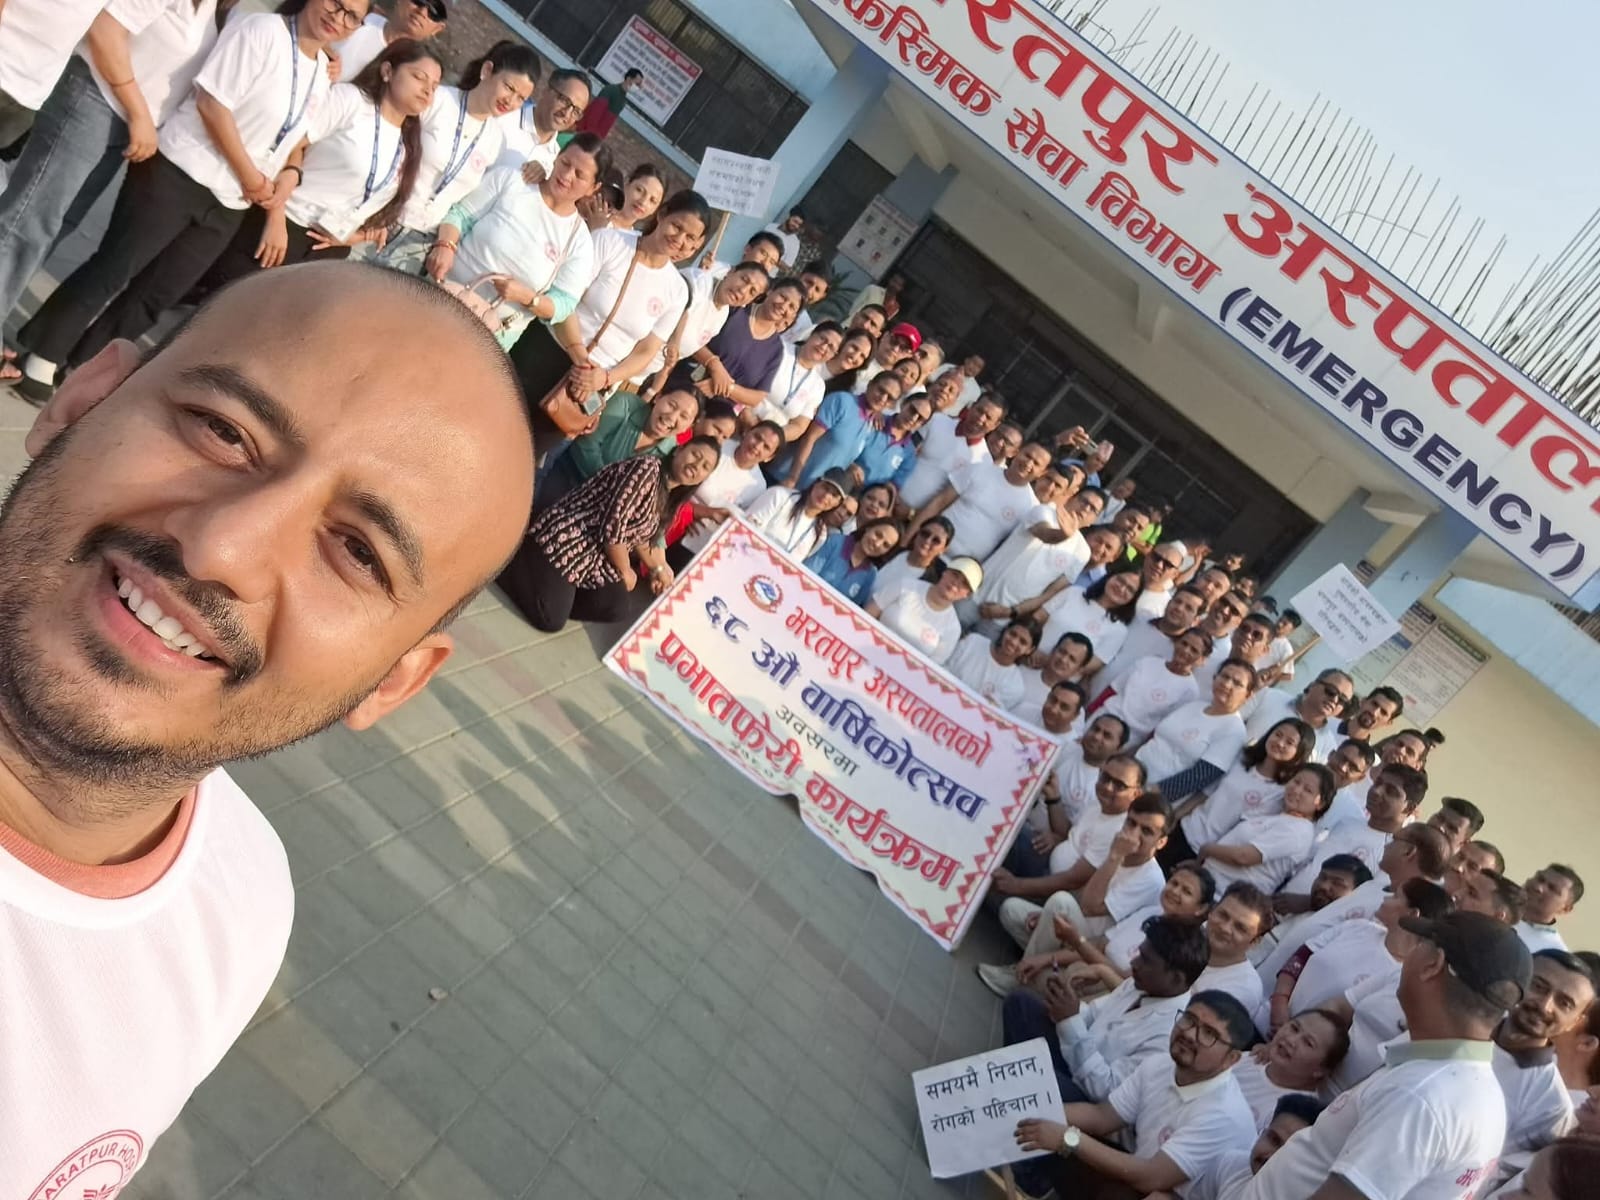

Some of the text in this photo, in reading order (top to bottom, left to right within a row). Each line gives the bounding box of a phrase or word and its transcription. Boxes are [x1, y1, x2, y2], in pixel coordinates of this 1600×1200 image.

[825, 0, 1003, 117] कस्मिक
[1004, 107, 1089, 188] सेवा
[1086, 170, 1222, 292] विभाग
[937, 0, 1220, 194] रतपुर
[1220, 286, 1586, 577] (EMERGENCY)
[655, 629, 962, 890] प्रभातफेरी कार्यक्रम
[704, 595, 749, 643] ६८
[801, 679, 990, 822] वार्षिकोत्सव
[774, 704, 862, 778] अवसरमा
[785, 605, 867, 681] भरतपुर
[863, 665, 993, 769] अस्पतालको
[925, 1056, 1044, 1100] समयमै निदान,
[931, 1105, 976, 1133] रोगको
[983, 1092, 1039, 1120] पहिचान
[38, 1142, 118, 1200] ARATPUR
